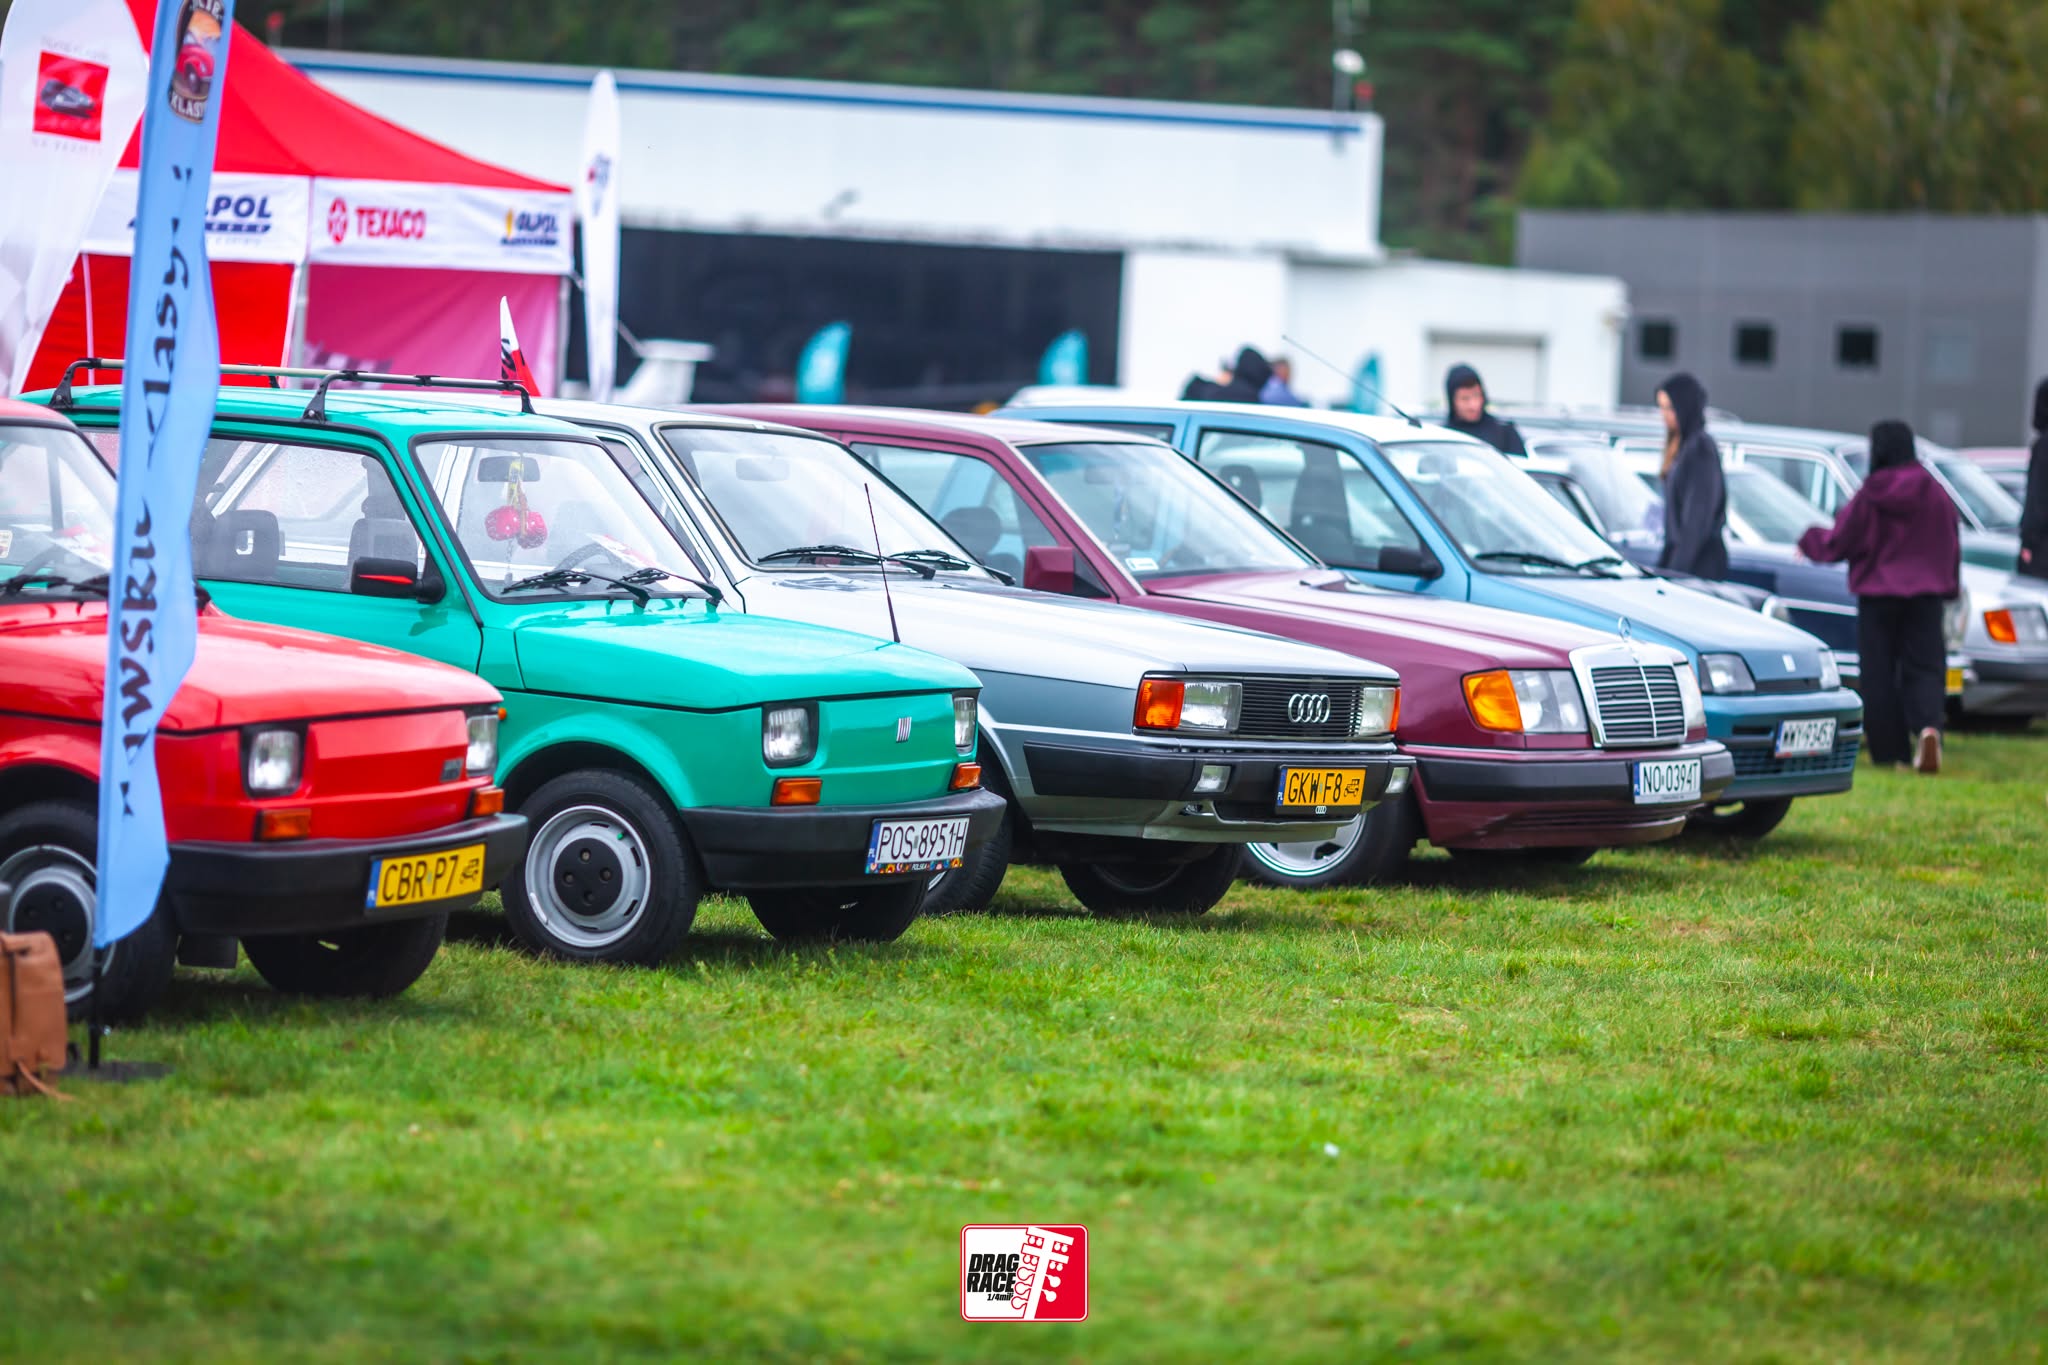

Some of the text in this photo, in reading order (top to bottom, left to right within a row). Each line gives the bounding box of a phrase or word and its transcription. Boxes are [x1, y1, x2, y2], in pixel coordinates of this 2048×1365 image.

[356, 208, 426, 239] TEXACO
[1287, 772, 1343, 803] GKW F8
[1643, 762, 1699, 793] NO 0394T
[877, 821, 968, 861] POS 8951H
[382, 854, 459, 902] CBR P7
